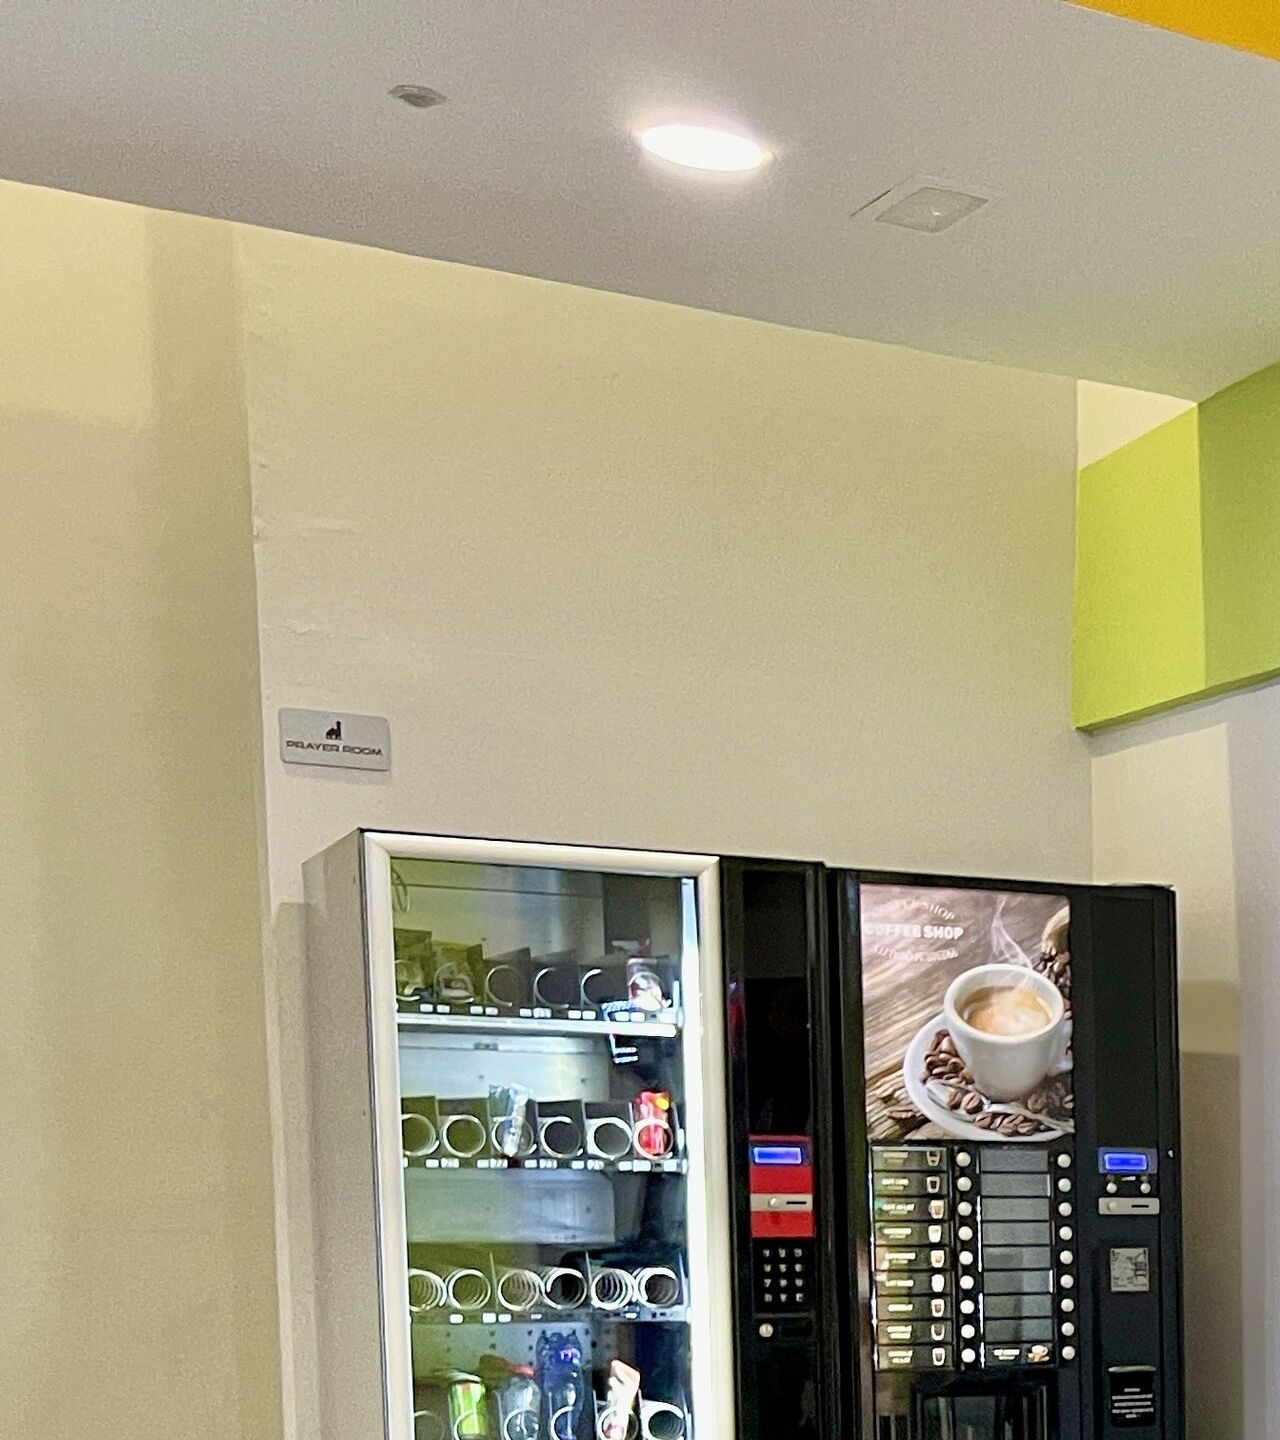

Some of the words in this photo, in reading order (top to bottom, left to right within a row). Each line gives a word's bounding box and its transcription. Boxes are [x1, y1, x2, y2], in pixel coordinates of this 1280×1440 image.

[286, 740, 340, 753] PRAYER
[342, 745, 383, 756] ROOM
[923, 925, 964, 939] SHOP
